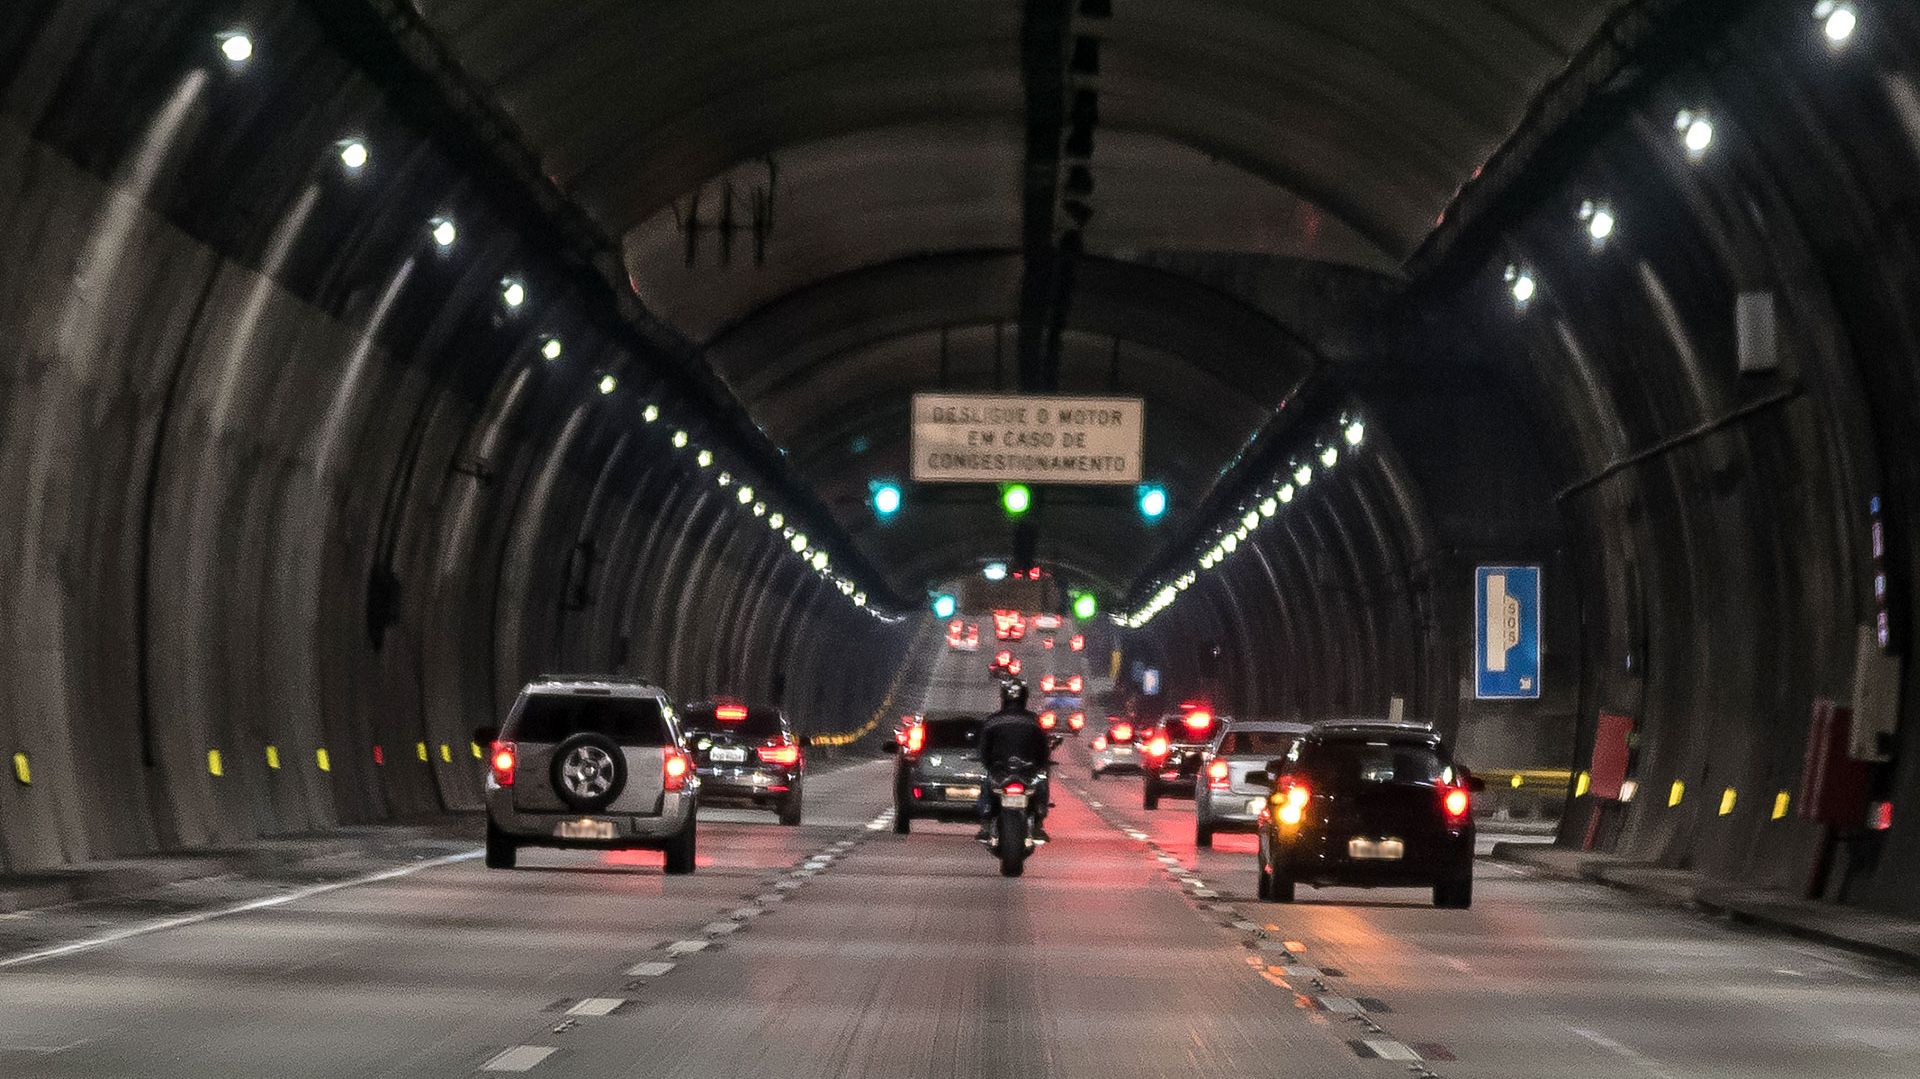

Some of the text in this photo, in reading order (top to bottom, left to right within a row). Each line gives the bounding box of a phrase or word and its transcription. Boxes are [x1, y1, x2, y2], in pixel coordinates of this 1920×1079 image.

[932, 406, 1122, 426] DESLIGUE O MOTOR
[968, 430, 1086, 448] EM CASO DE
[928, 452, 1125, 472] CONGESTIONAMENTO
[1507, 602, 1516, 643] SOS
